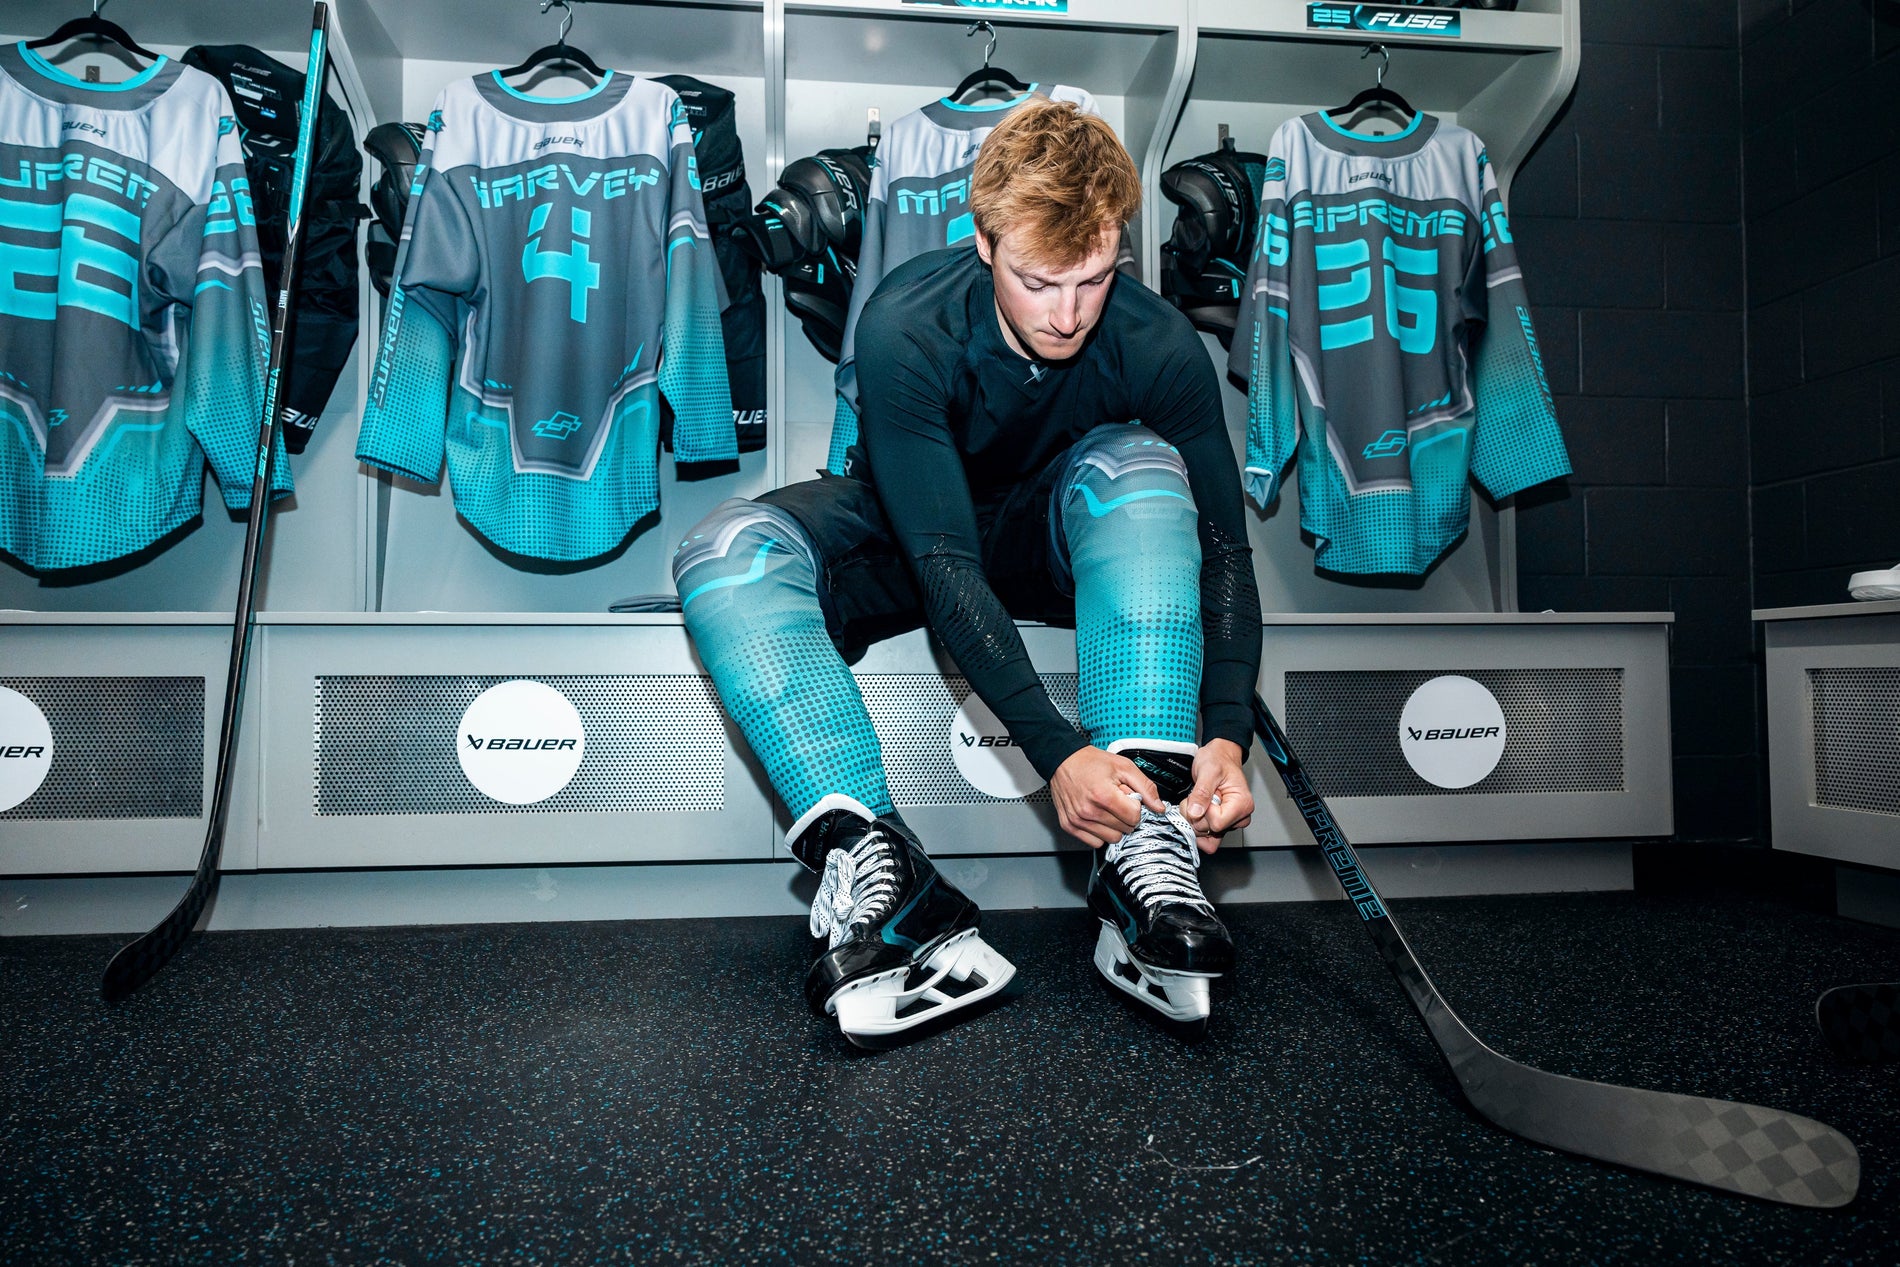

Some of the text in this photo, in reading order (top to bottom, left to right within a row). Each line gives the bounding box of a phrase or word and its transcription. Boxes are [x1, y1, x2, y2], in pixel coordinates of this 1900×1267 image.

[1313, 8, 1454, 30] 25 FUSE
[62, 121, 107, 138] AUER
[533, 136, 584, 150] BAUER
[521, 203, 600, 324] 4
[1315, 236, 1439, 354] 26
[1424, 727, 1500, 741] BAUER
[486, 738, 577, 750] BAUER
[1282, 771, 1387, 921] SUPREME
